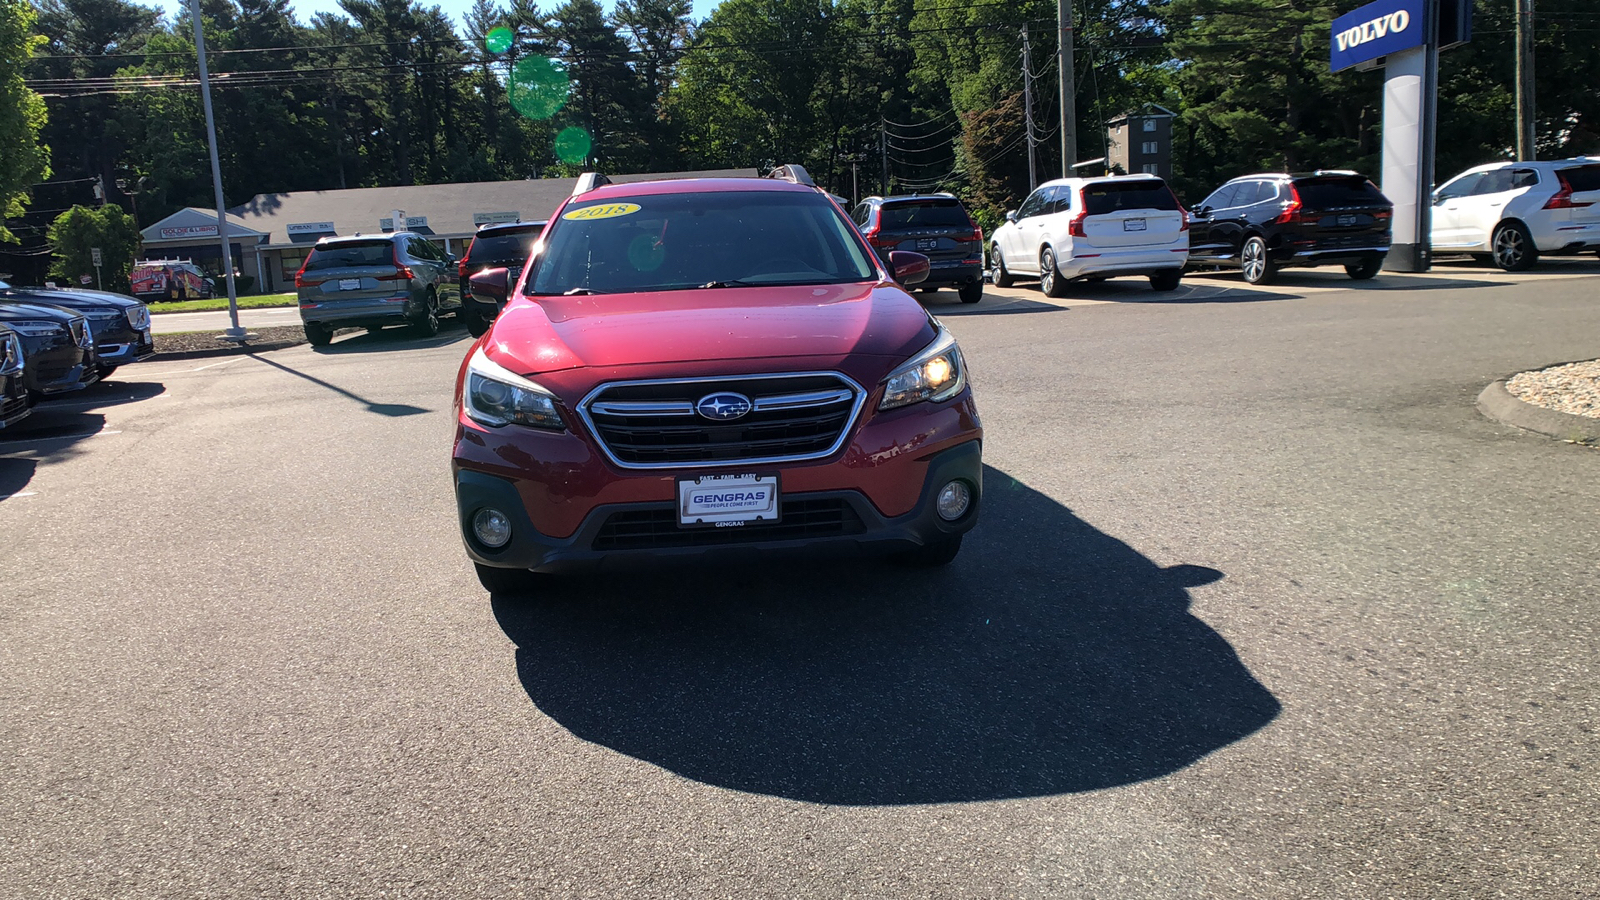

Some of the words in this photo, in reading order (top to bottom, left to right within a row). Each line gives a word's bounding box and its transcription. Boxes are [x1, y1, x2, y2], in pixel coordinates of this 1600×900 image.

[1335, 9, 1410, 52] VOLVO
[575, 205, 629, 219] 2018
[693, 492, 765, 503] GENGRAS
[715, 520, 745, 528] GENGRAS
